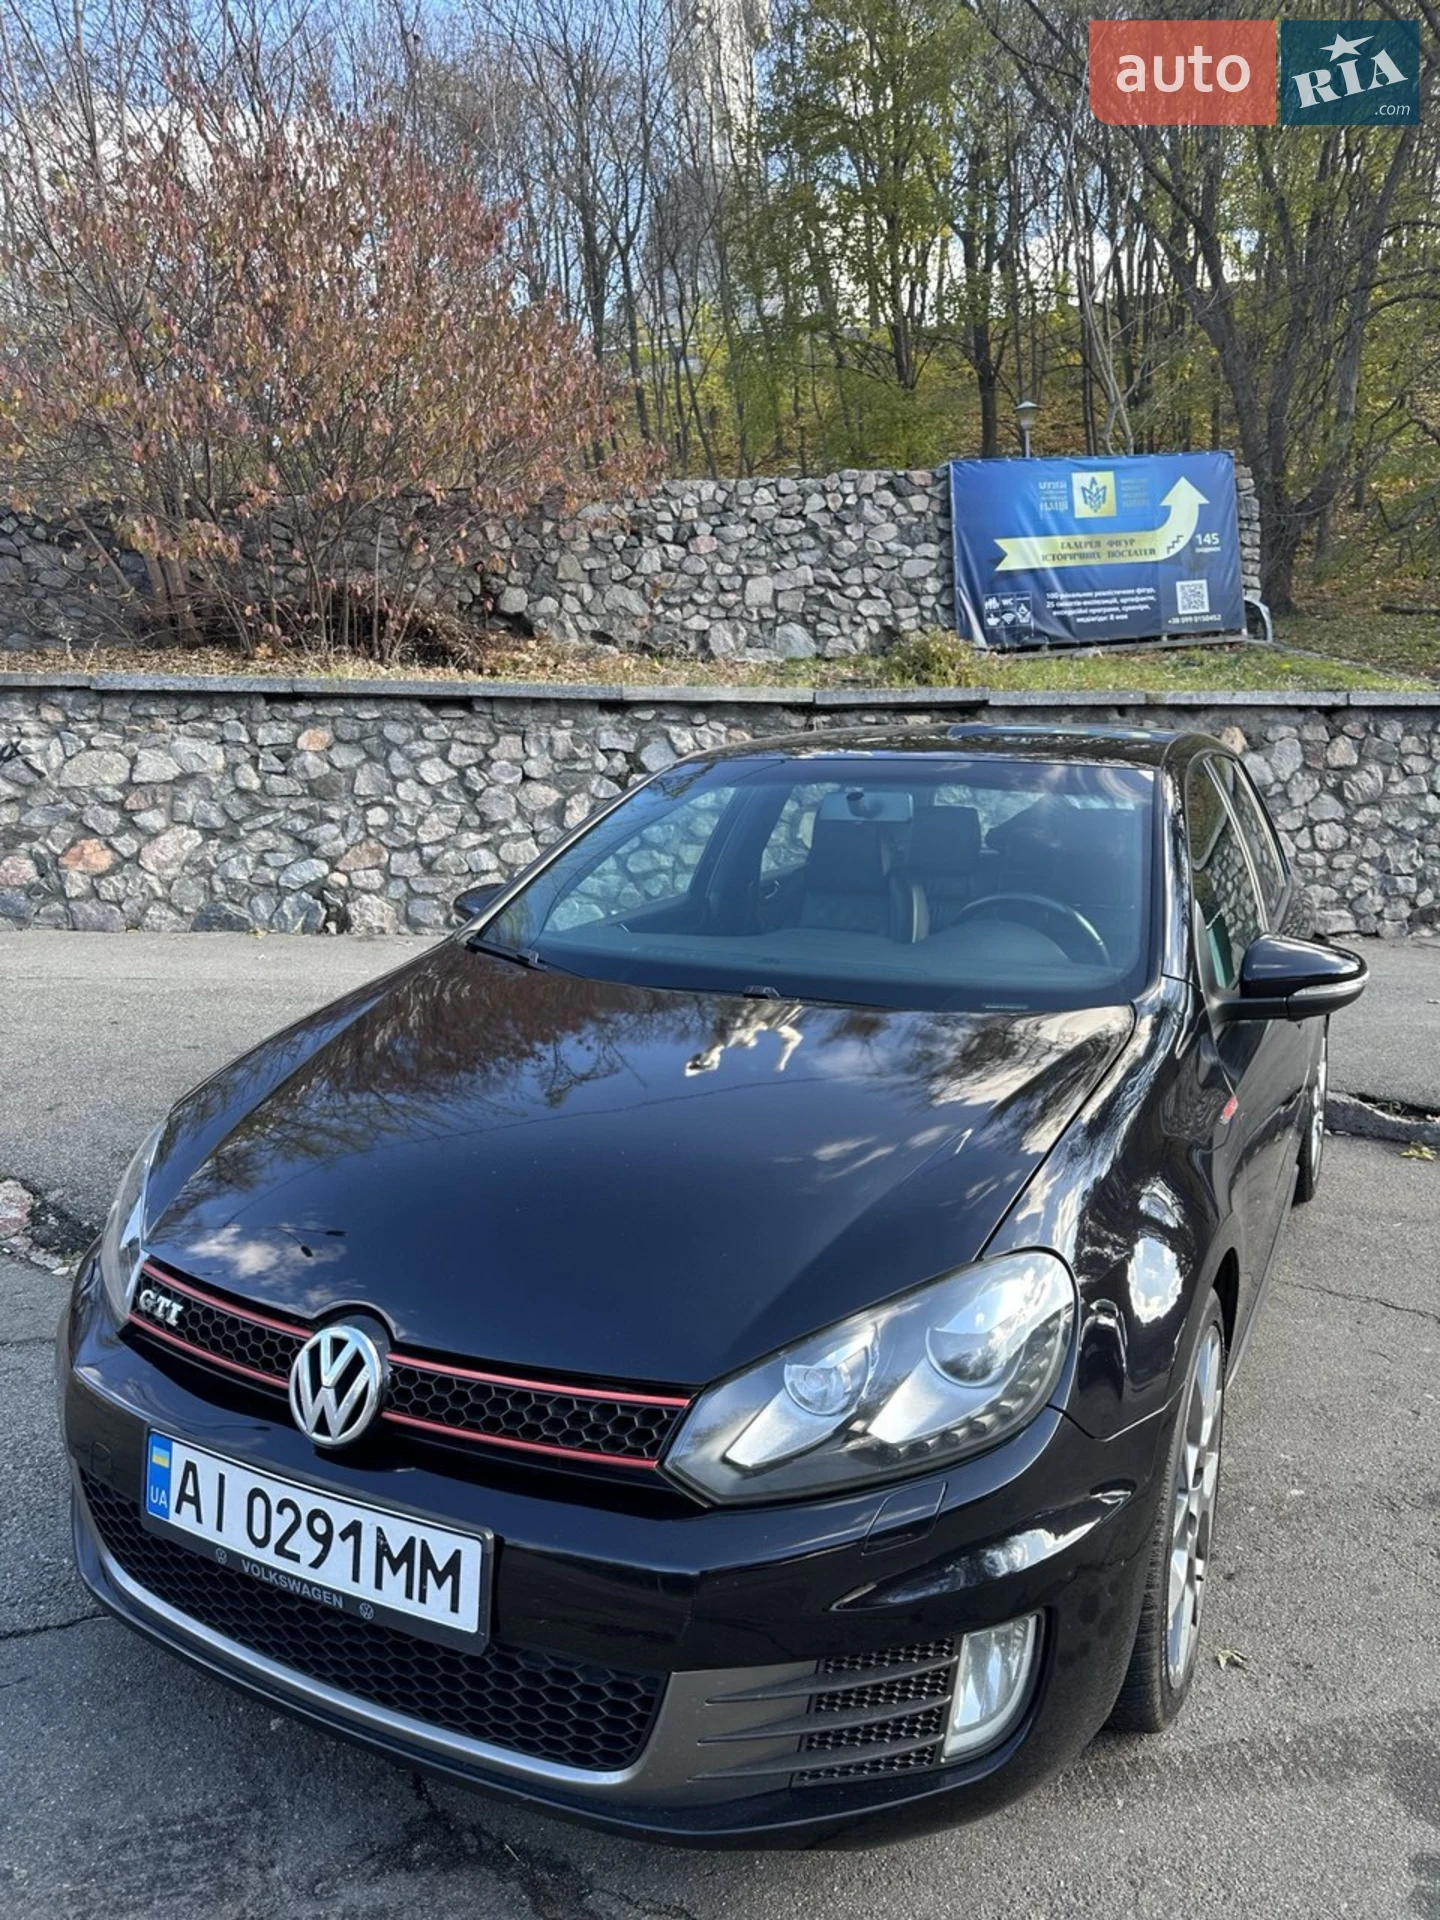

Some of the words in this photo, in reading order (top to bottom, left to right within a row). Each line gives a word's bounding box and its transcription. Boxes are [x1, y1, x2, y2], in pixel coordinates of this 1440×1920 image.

[1195, 533, 1219, 545] 145
[139, 1289, 184, 1326] GTI
[150, 1484, 168, 1509] UA
[241, 1560, 344, 1609] VOLKSWAGEN
